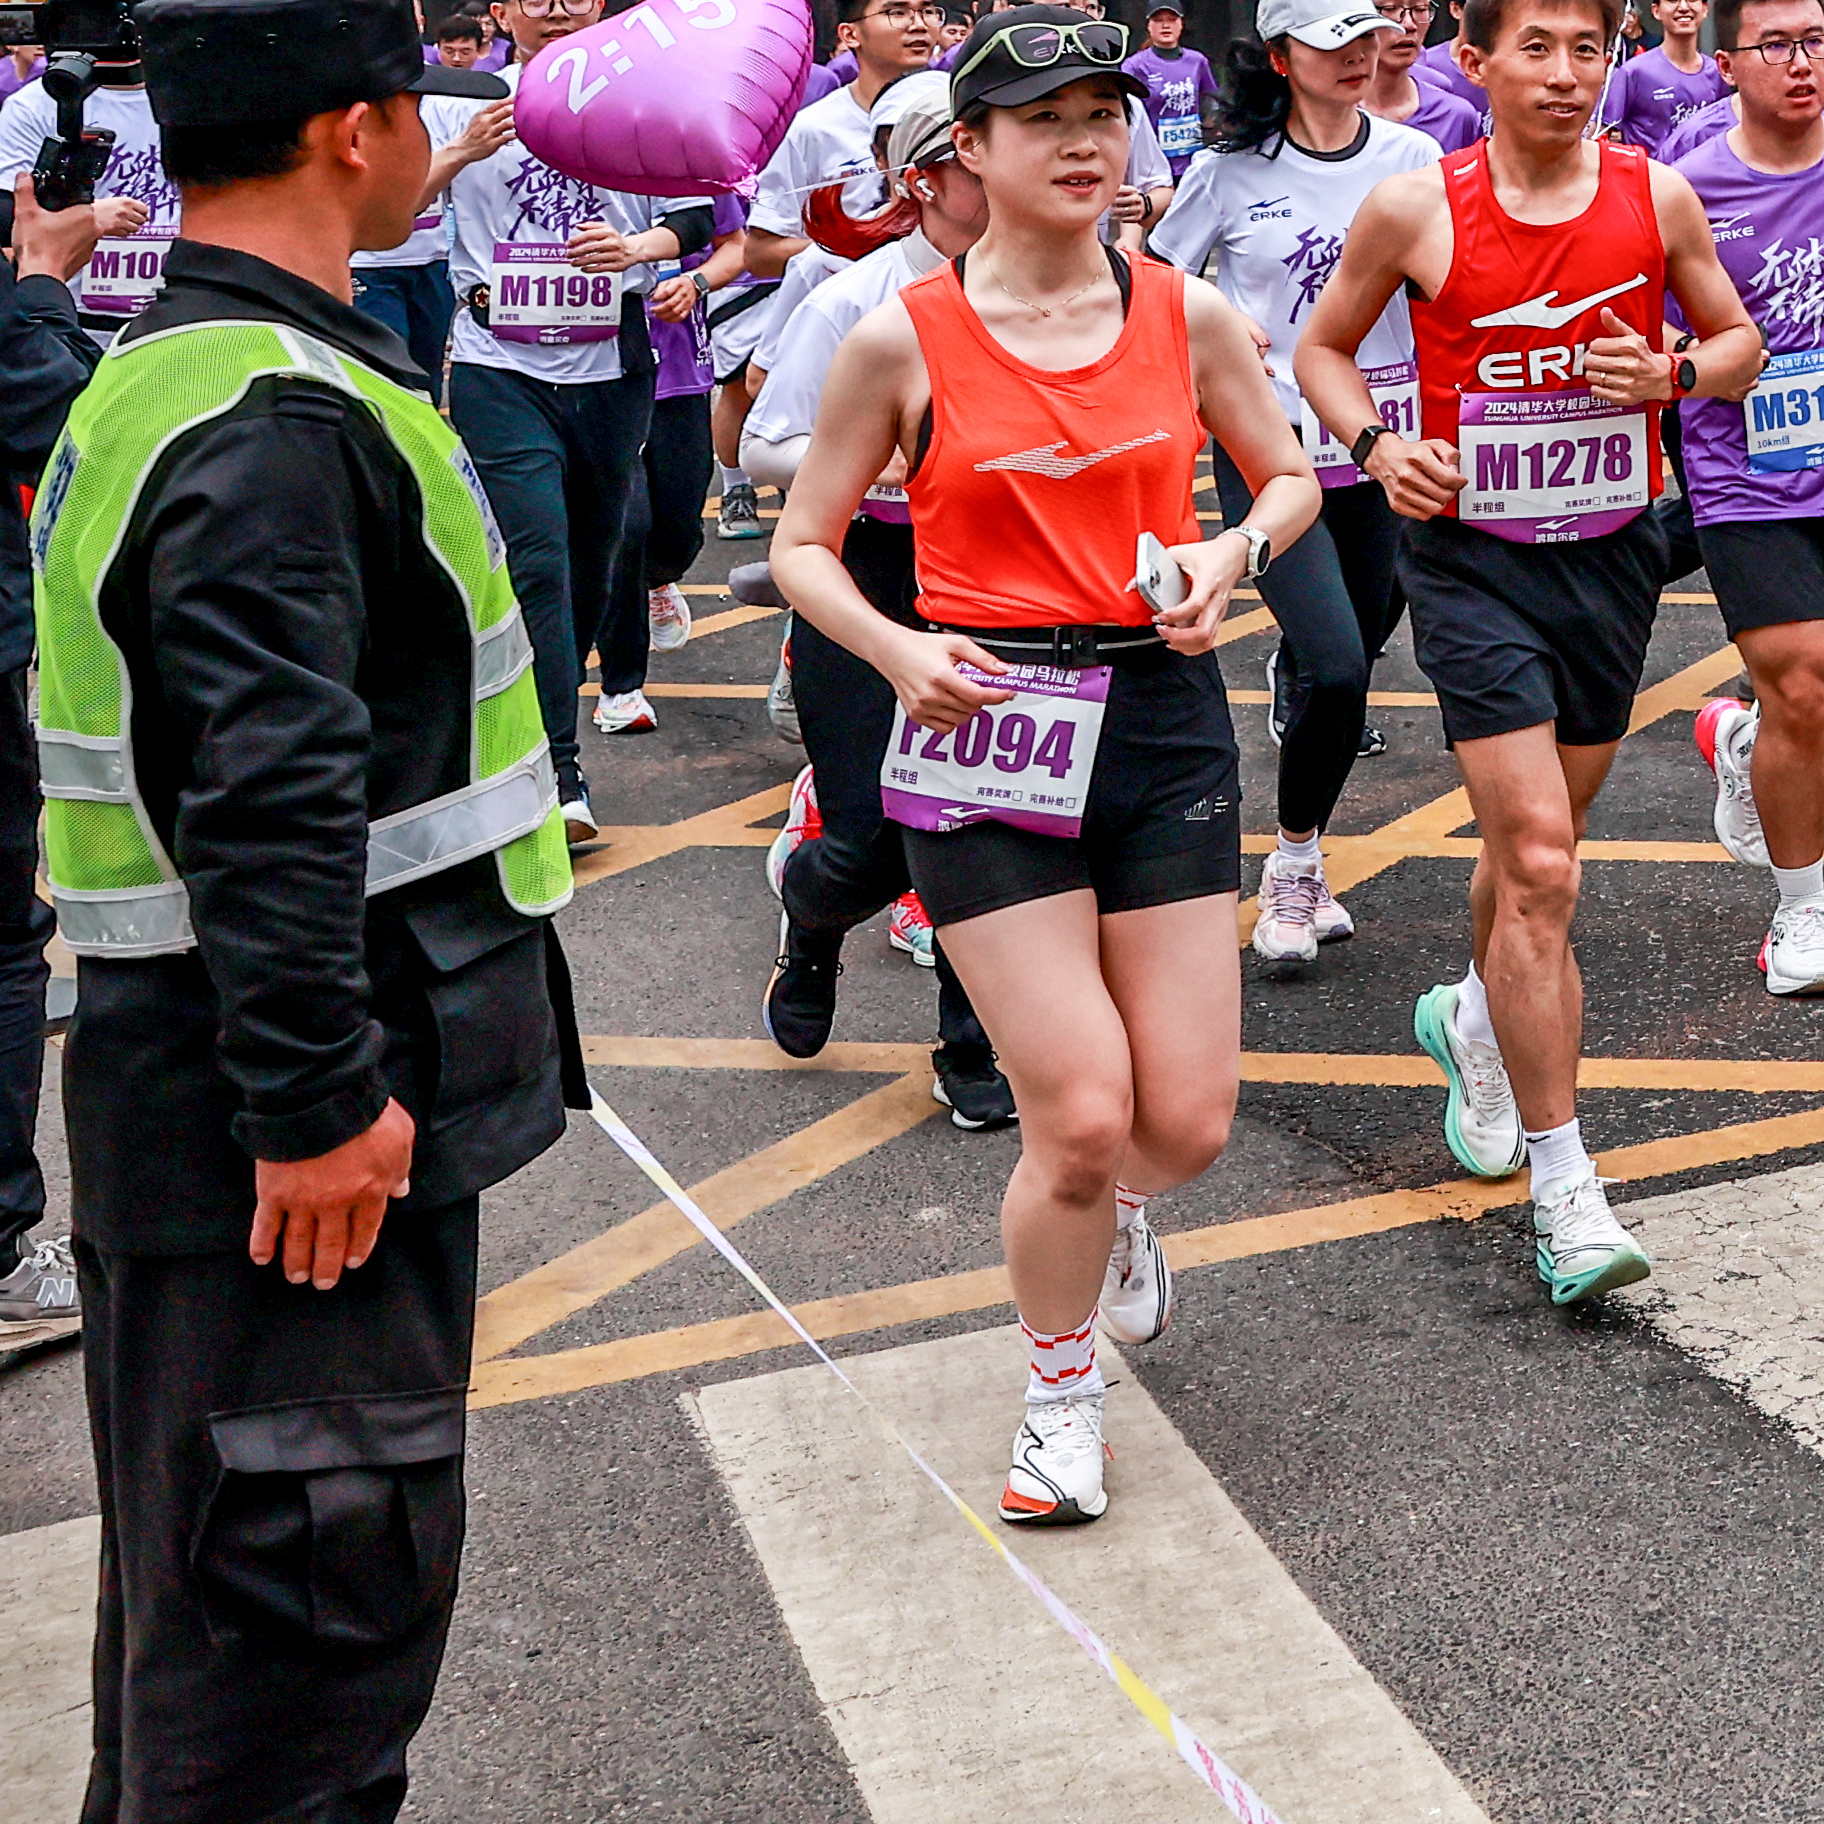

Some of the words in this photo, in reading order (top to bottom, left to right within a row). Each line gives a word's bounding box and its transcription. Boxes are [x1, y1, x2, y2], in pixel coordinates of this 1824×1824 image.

[1250, 209, 1292, 222] ERKE
[1713, 226, 1755, 243] ERKE
[91, 251, 168, 280] M10
[500, 275, 612, 308] M1198
[1484, 395, 1612, 415] 2024清华大学校园马拉
[1475, 433, 1632, 491] M1278
[1472, 502, 1505, 514] 半程组
[994, 676, 1029, 688] CAMPUS
[1029, 681, 1077, 694] MARATHON
[890, 766, 918, 785] 半程组
[1029, 792, 1065, 807] 完赛补给
